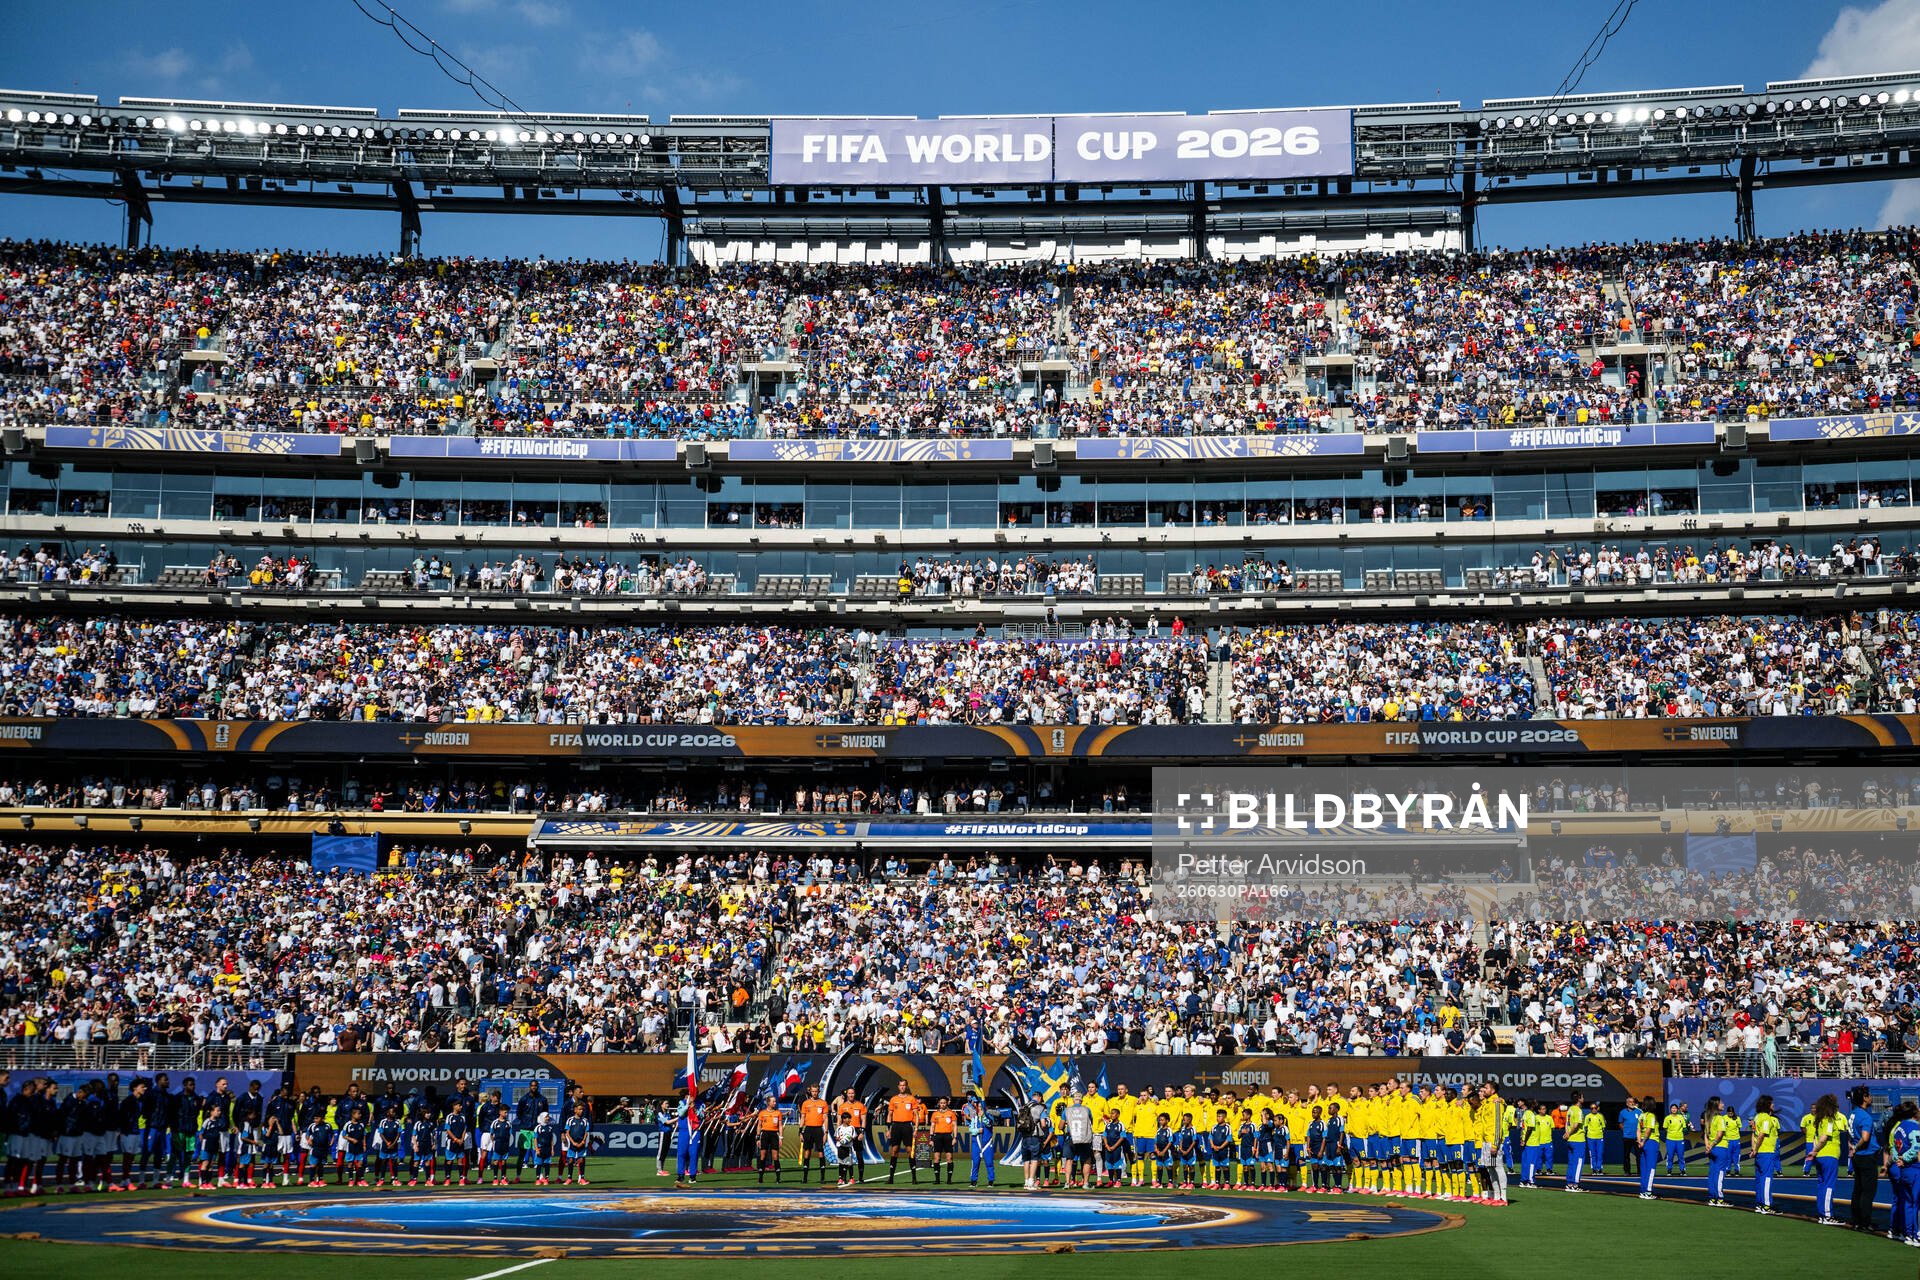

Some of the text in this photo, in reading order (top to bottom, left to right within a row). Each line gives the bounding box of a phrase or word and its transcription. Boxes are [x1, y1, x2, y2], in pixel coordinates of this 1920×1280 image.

[802, 126, 1320, 164] FIFA WORLD CUP 2026
[1509, 427, 1622, 447] #FIFAWorldCup
[480, 438, 589, 458] #FIFAWorldCup
[424, 732, 470, 746] SWEDEN
[549, 734, 737, 747] FIFA WORLD CUP 2026
[1258, 733, 1305, 747] SWEDEN
[1385, 729, 1579, 745] FIFA WORLD CUP 2026
[1690, 726, 1738, 741] SWEDEN
[841, 735, 886, 748] SWEDEN
[944, 824, 1089, 835] #FIFAWorldCup
[351, 1068, 551, 1081] FIFA WORLD CUP 2026
[1222, 1071, 1270, 1085] SWEDEN
[1503, 1074, 1538, 1087] CUP
[1541, 1073, 1602, 1087] 2026
